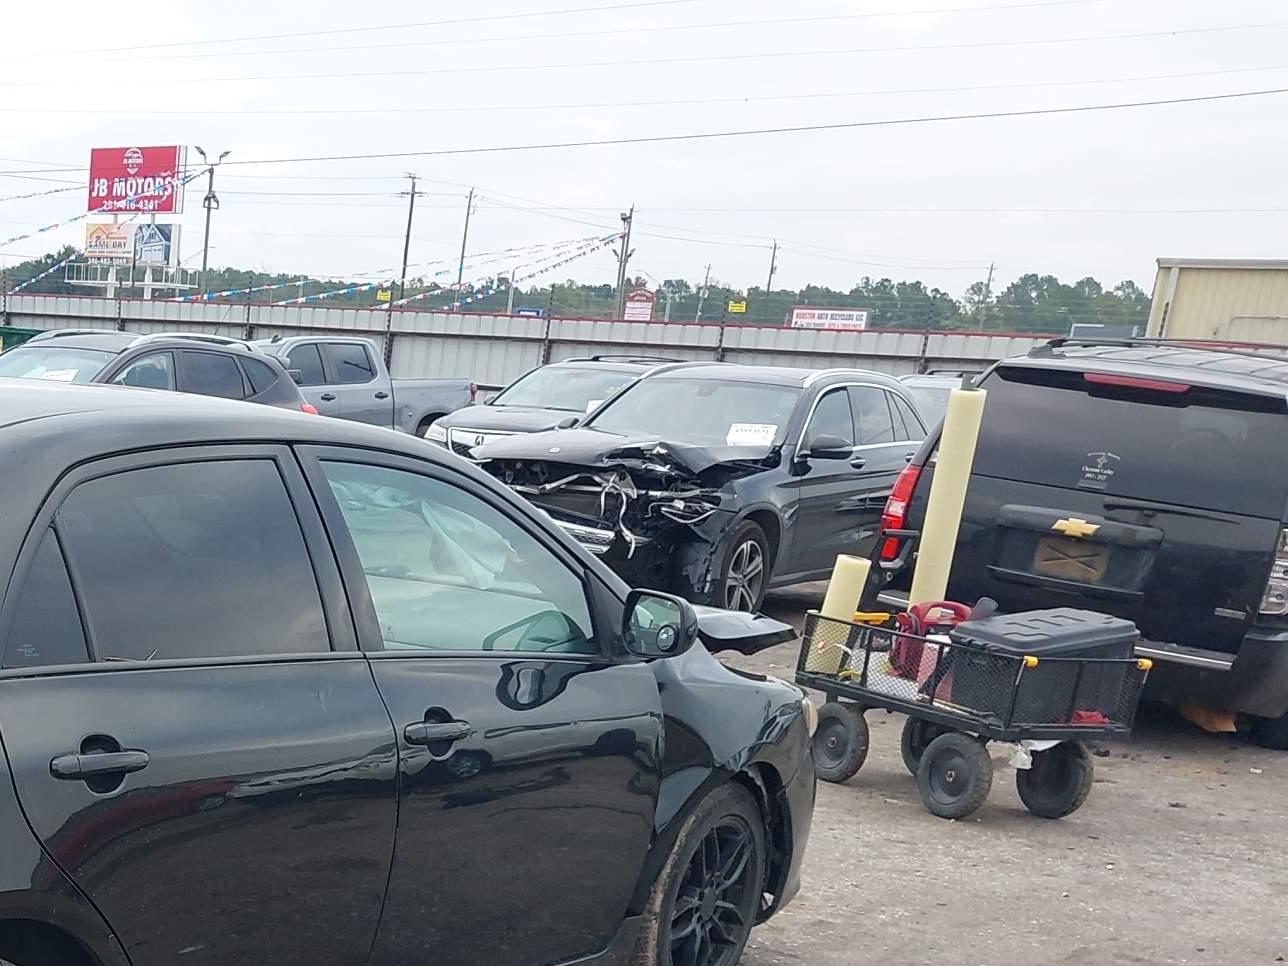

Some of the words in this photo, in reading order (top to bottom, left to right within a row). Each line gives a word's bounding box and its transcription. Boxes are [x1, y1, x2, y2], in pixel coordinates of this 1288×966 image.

[92, 178, 108, 197] JB
[112, 176, 172, 197] MOTORS
[88, 240, 109, 249] SAME
[112, 240, 128, 249] DAY
